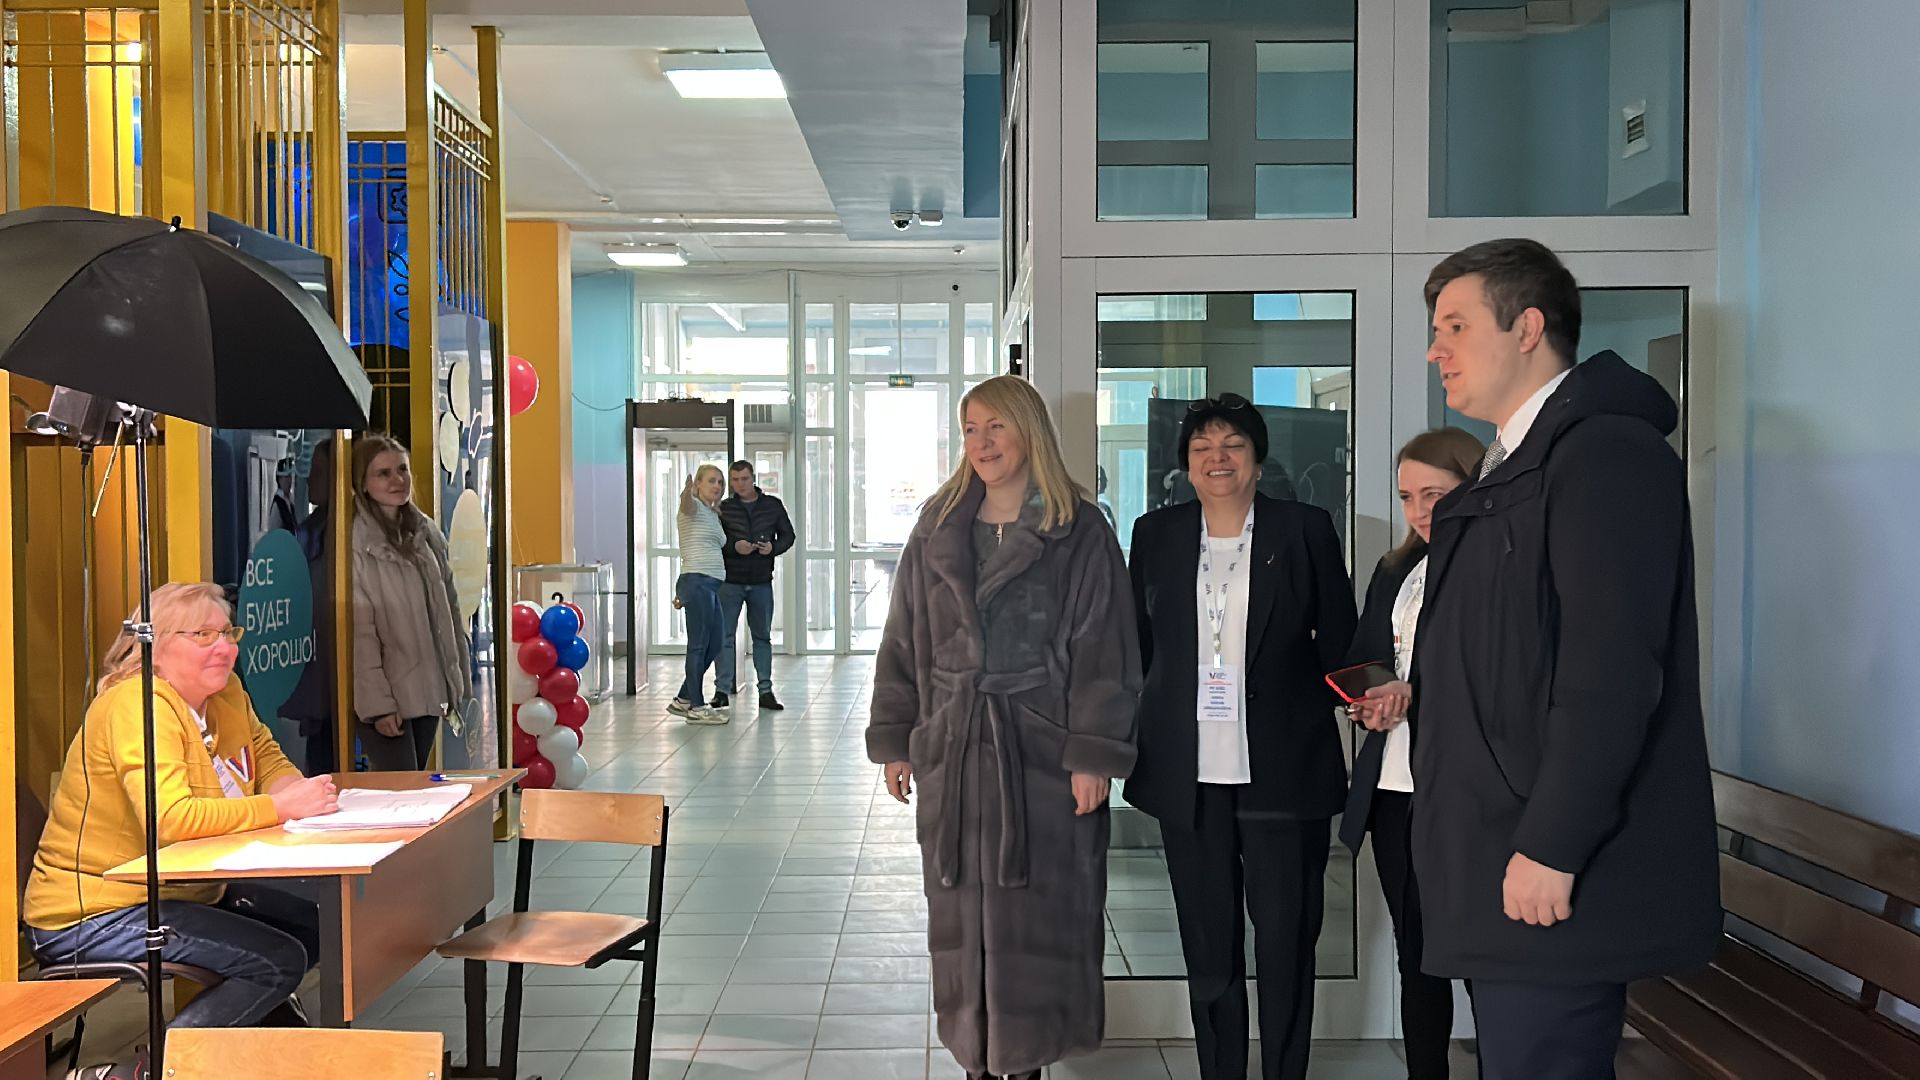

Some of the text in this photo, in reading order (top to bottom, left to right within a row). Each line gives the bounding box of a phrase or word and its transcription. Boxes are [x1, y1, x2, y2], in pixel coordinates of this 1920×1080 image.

[246, 558, 274, 587] ВСЕ
[246, 598, 291, 635] БУДЕТ
[247, 628, 317, 675] ХОРОШО!
